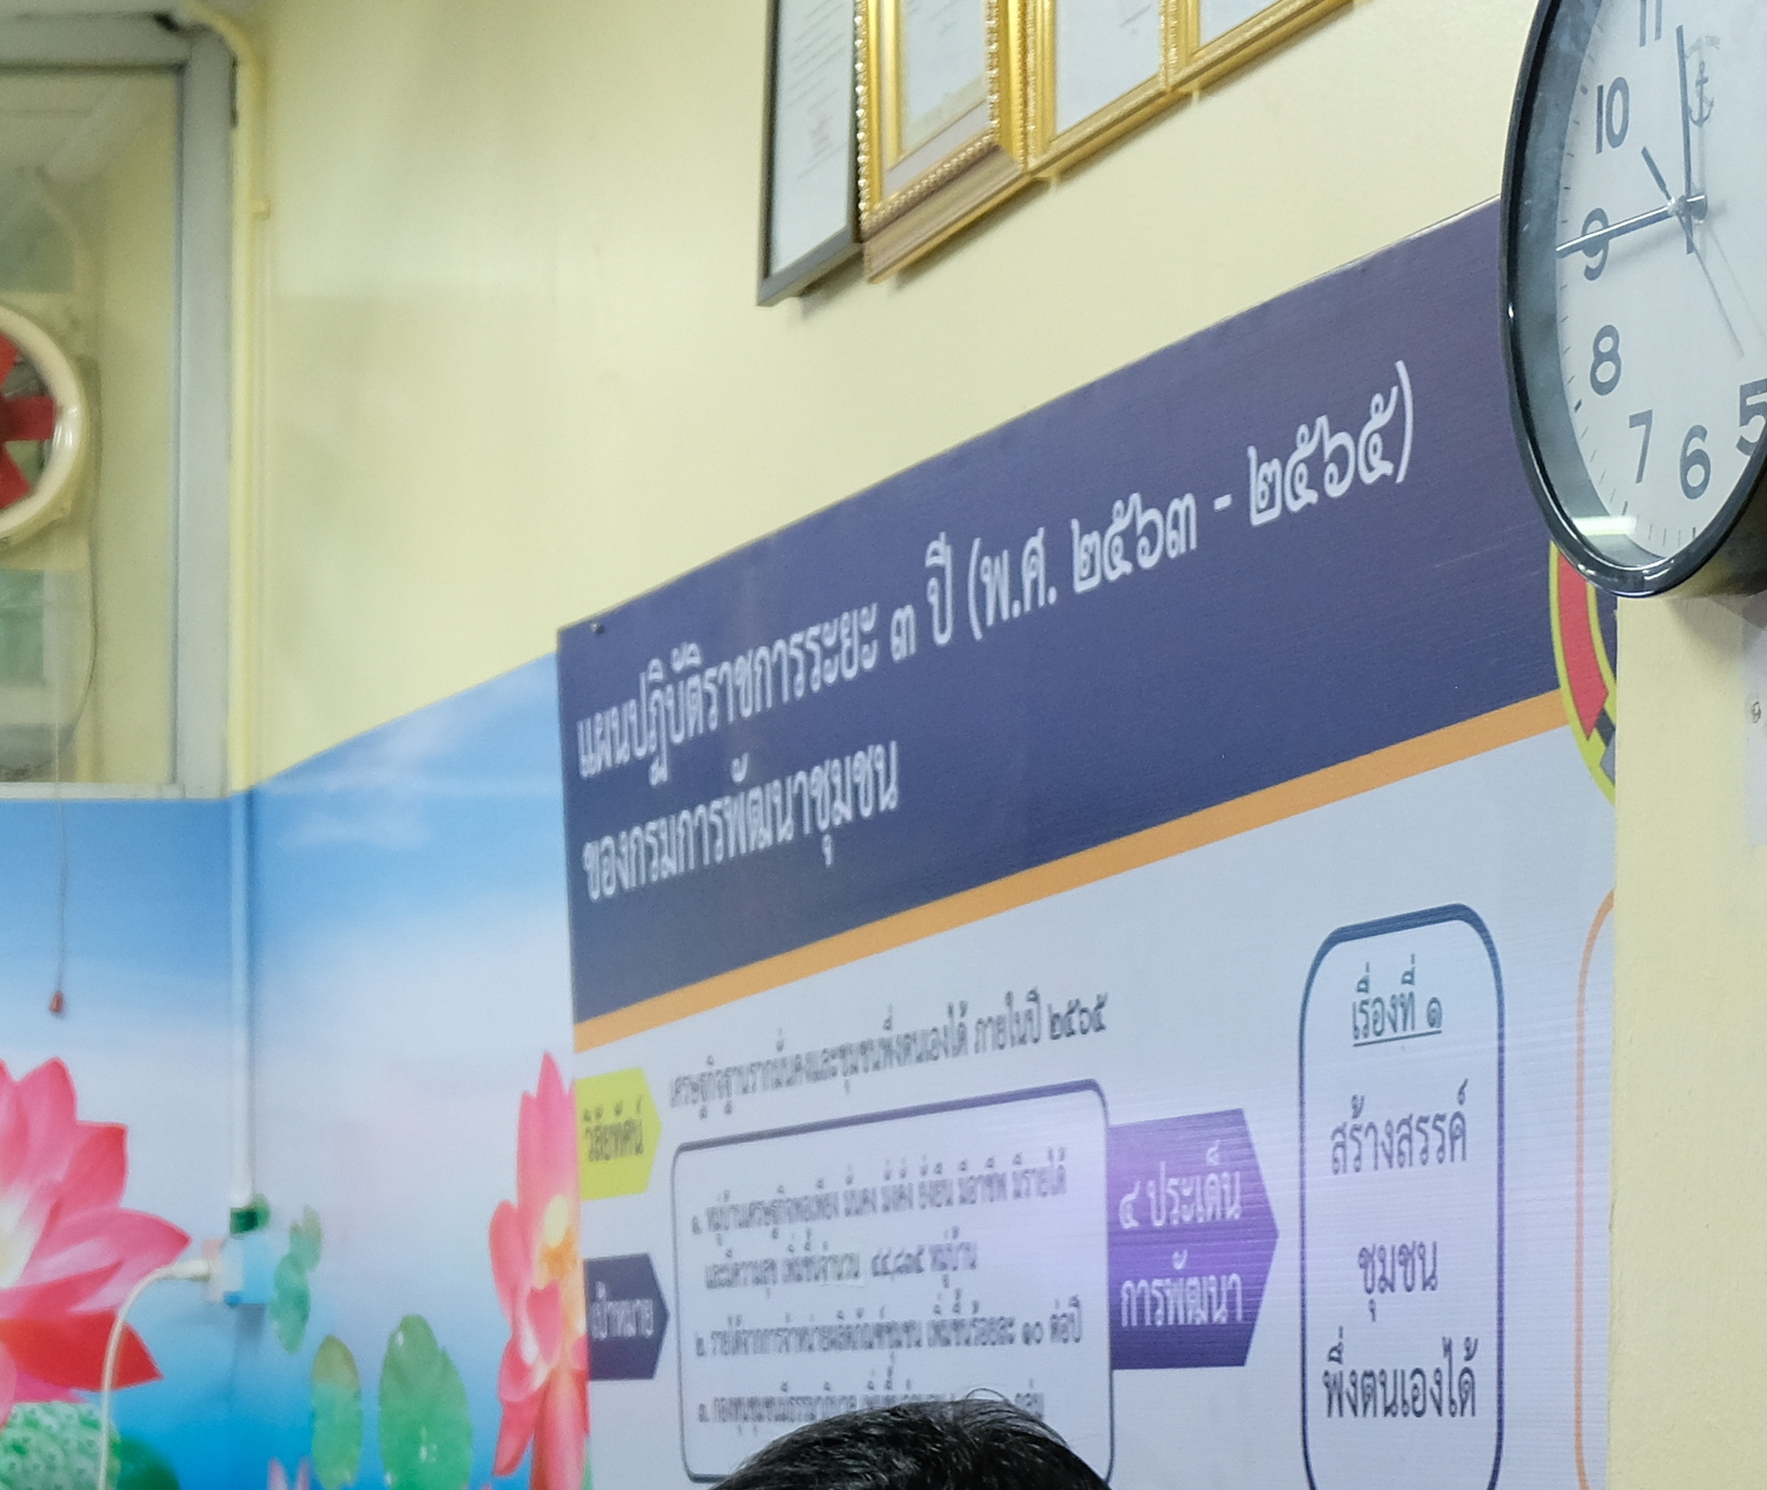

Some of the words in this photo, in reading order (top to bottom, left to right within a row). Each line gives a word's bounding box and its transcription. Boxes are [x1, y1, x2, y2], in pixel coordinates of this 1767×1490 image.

[1595, 76, 1630, 154] 10
[1579, 207, 1610, 282] 9
[1589, 324, 1621, 397] 8
[1627, 408, 1654, 484] 7
[1679, 423, 1711, 500] 6
[578, 600, 879, 787] แผนปฏิบัติราชการระยะ
[889, 604, 917, 663] ๓
[924, 531, 955, 648] ปี
[967, 527, 1058, 641] (พ.ศ.
[1069, 492, 1198, 595] ๒๕๖๓
[1247, 359, 1415, 527] ๒๕๖๕)
[581, 740, 899, 903] ของกรมการพัฒนาชุมชน
[1352, 954, 1416, 1041] เรื่องที่
[1426, 996, 1443, 1031] ๑
[1330, 1078, 1469, 1177] สร้างสรรค์
[1118, 1180, 1142, 1230] ๔
[1146, 1143, 1243, 1227] ประเด็น
[1121, 1248, 1244, 1329] การพัฒนา
[1357, 1239, 1439, 1324] ชุมชน
[1321, 1326, 1480, 1420] พึ่งตนเองได้
